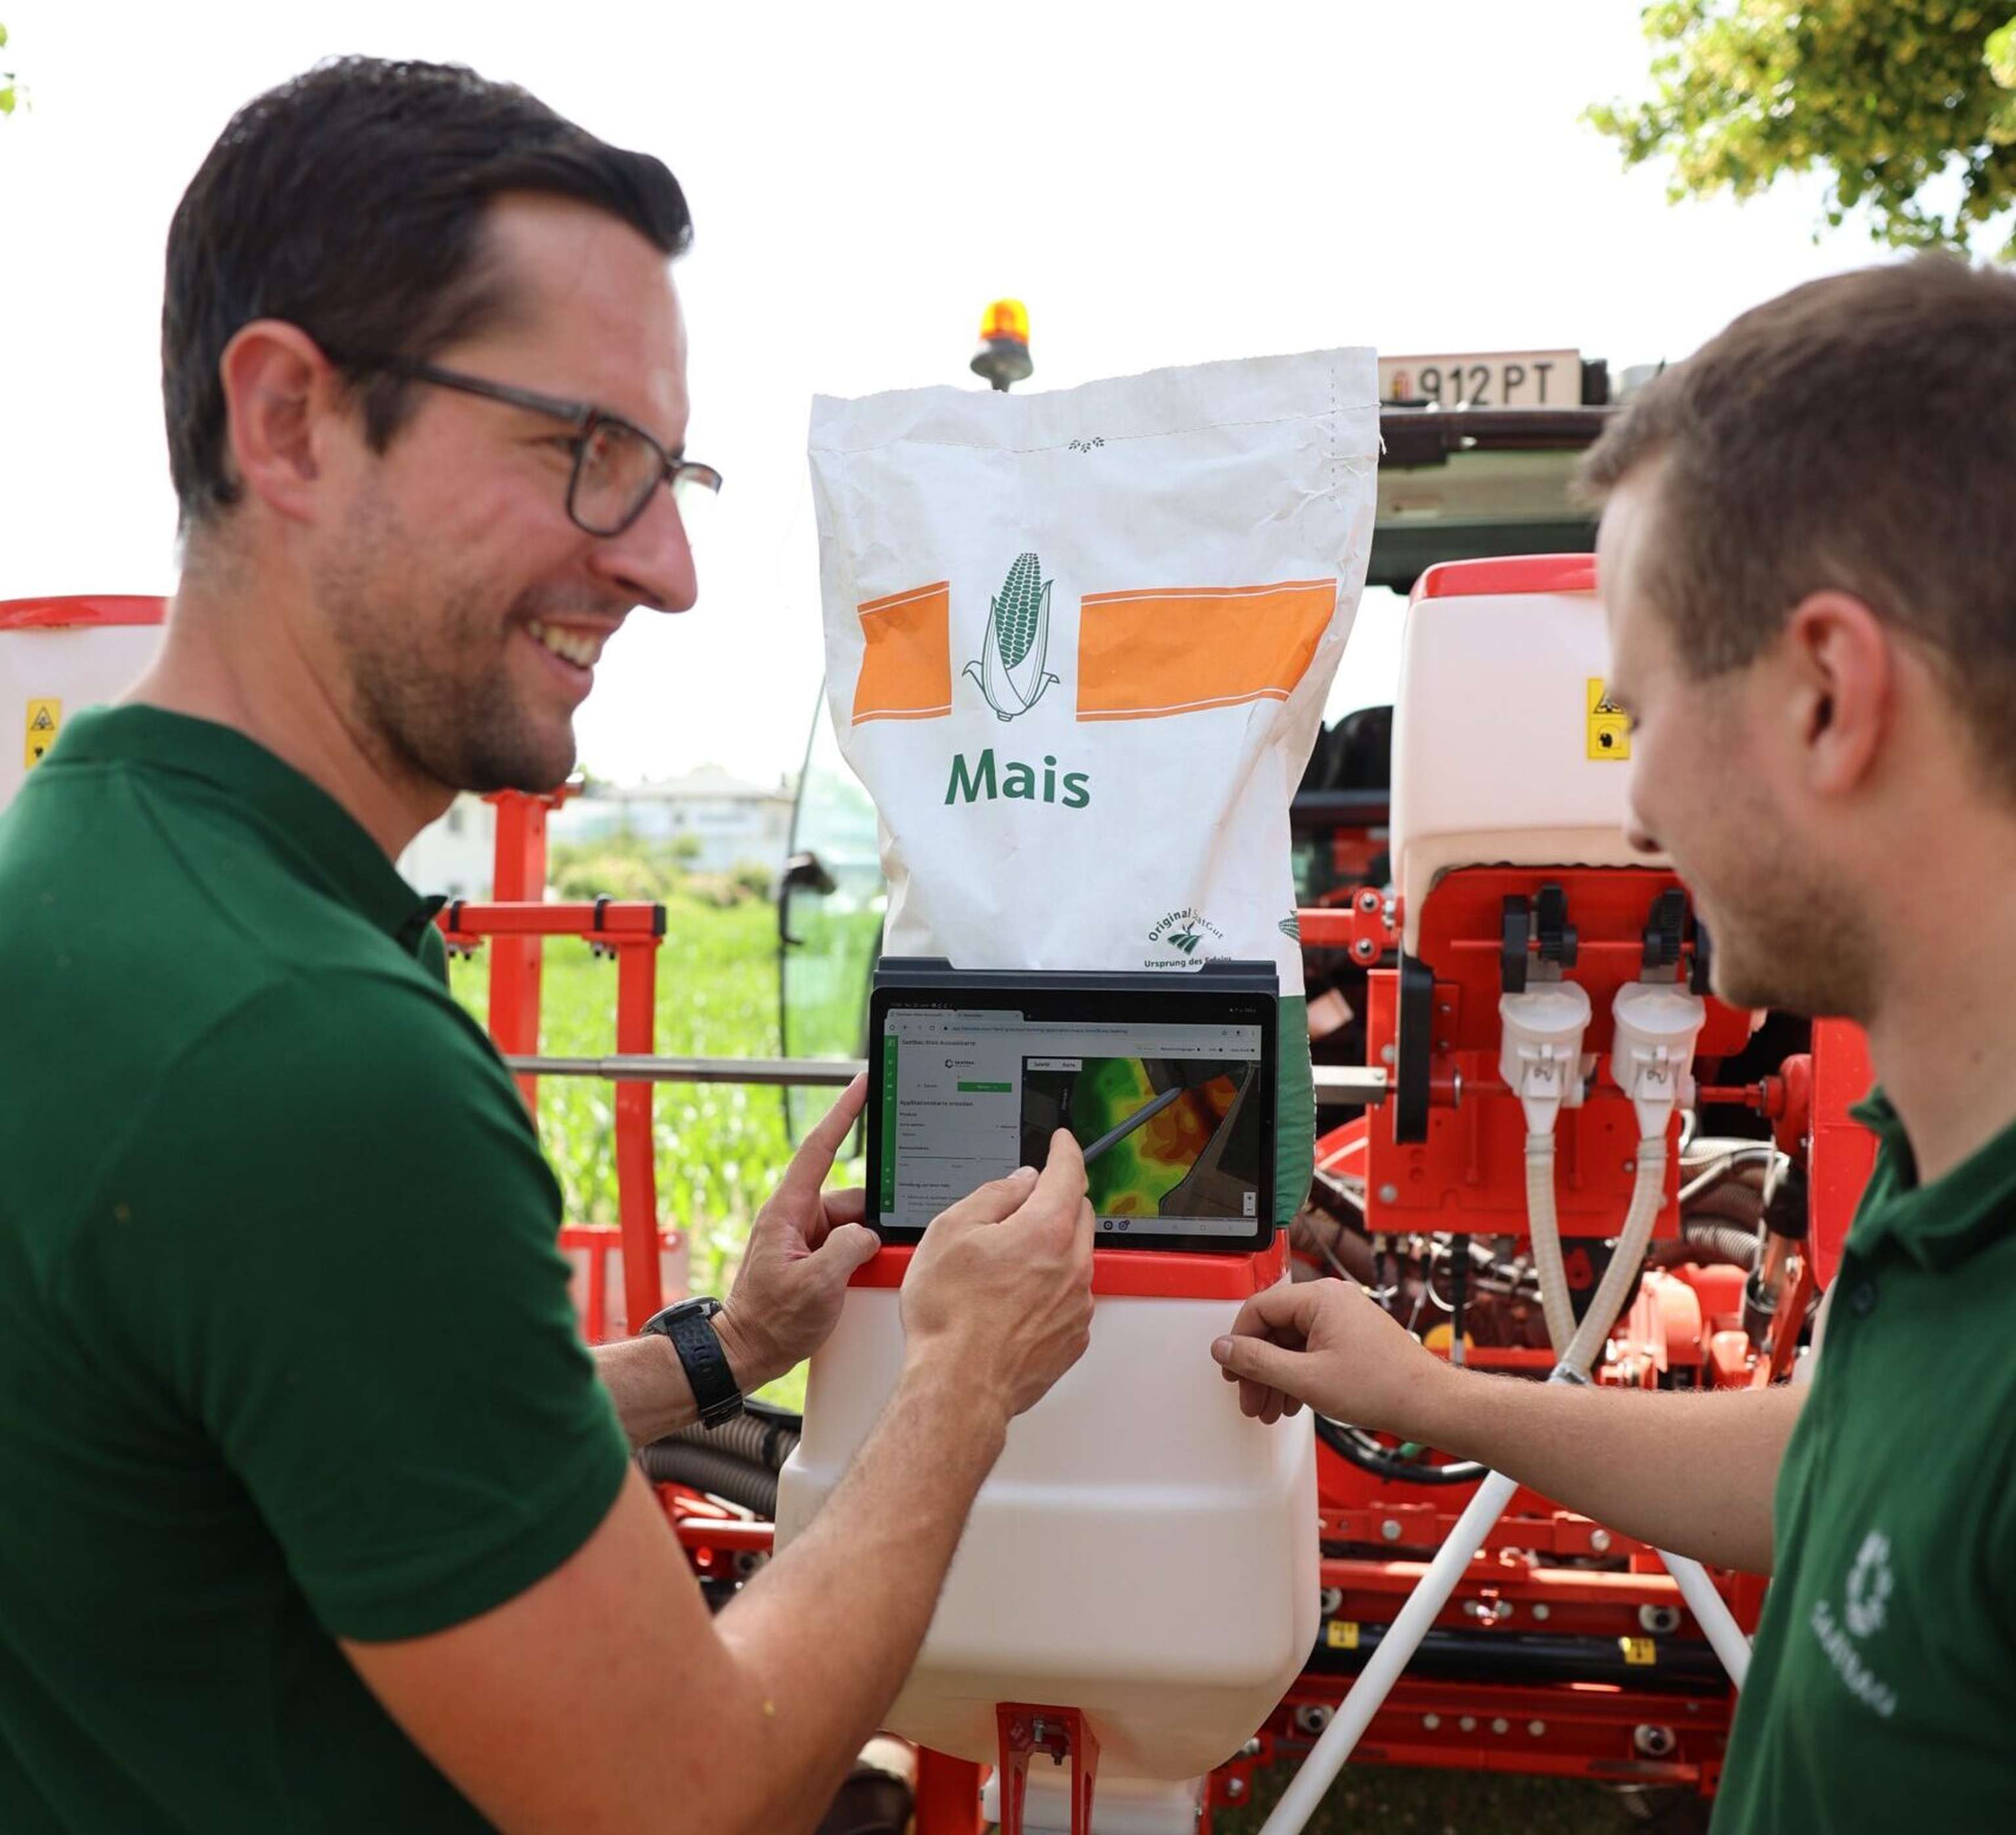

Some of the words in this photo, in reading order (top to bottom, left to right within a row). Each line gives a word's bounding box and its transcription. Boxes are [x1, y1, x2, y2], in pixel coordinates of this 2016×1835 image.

[945, 748, 1090, 809] Mais
[1148, 907, 1191, 941] Original
[1144, 959, 1186, 968] Ursprung
